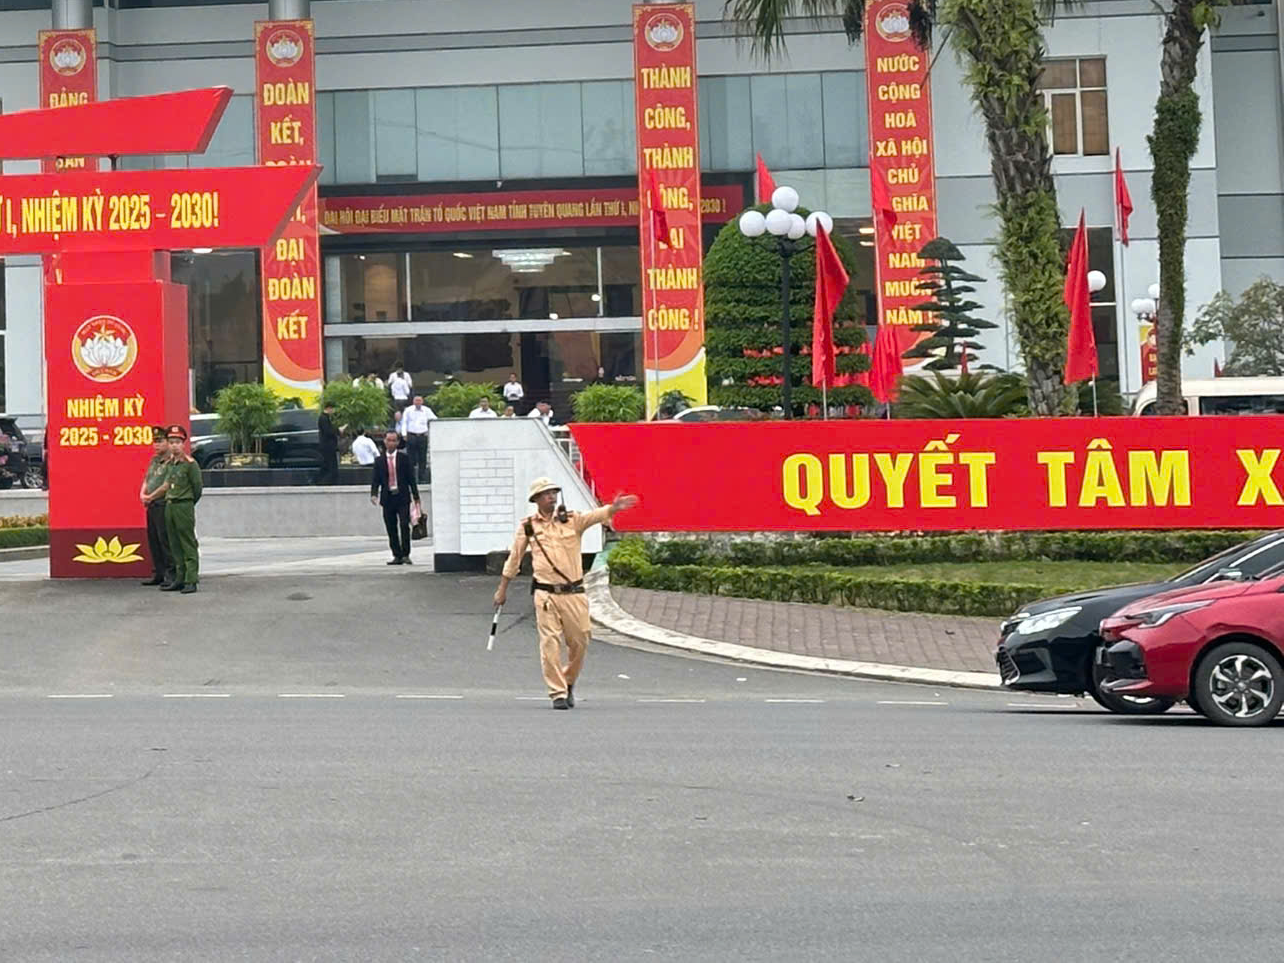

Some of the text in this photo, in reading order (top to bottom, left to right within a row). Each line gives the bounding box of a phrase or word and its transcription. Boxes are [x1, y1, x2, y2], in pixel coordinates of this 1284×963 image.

[640, 63, 692, 90] THÀNH
[876, 53, 920, 73] NƯỚC
[262, 77, 310, 106] ĐOÀN
[877, 81, 921, 104] CỘNG
[270, 114, 305, 146] KẾT,
[644, 103, 691, 131] CÔNG,
[642, 142, 694, 170] THÀNH
[875, 136, 928, 159] XÃ HỘI
[887, 162, 920, 185] CHỦ
[21, 189, 78, 241] NHIỆM
[82, 188, 105, 232] KỲ
[108, 194, 151, 231] 2025
[170, 191, 219, 229] 2030!
[891, 192, 929, 213] GHĨA
[275, 237, 305, 266] ĐẠI
[267, 272, 315, 302] ĐOÀN
[648, 264, 697, 290] THÀNH
[277, 309, 308, 340] KẾT
[648, 305, 690, 331] CÔNG
[67, 393, 145, 422] NHIỆM KỲ
[59, 426, 99, 446] 2025
[113, 425, 154, 446] 2030
[782, 433, 1284, 516] QUYẾT TÂM X
